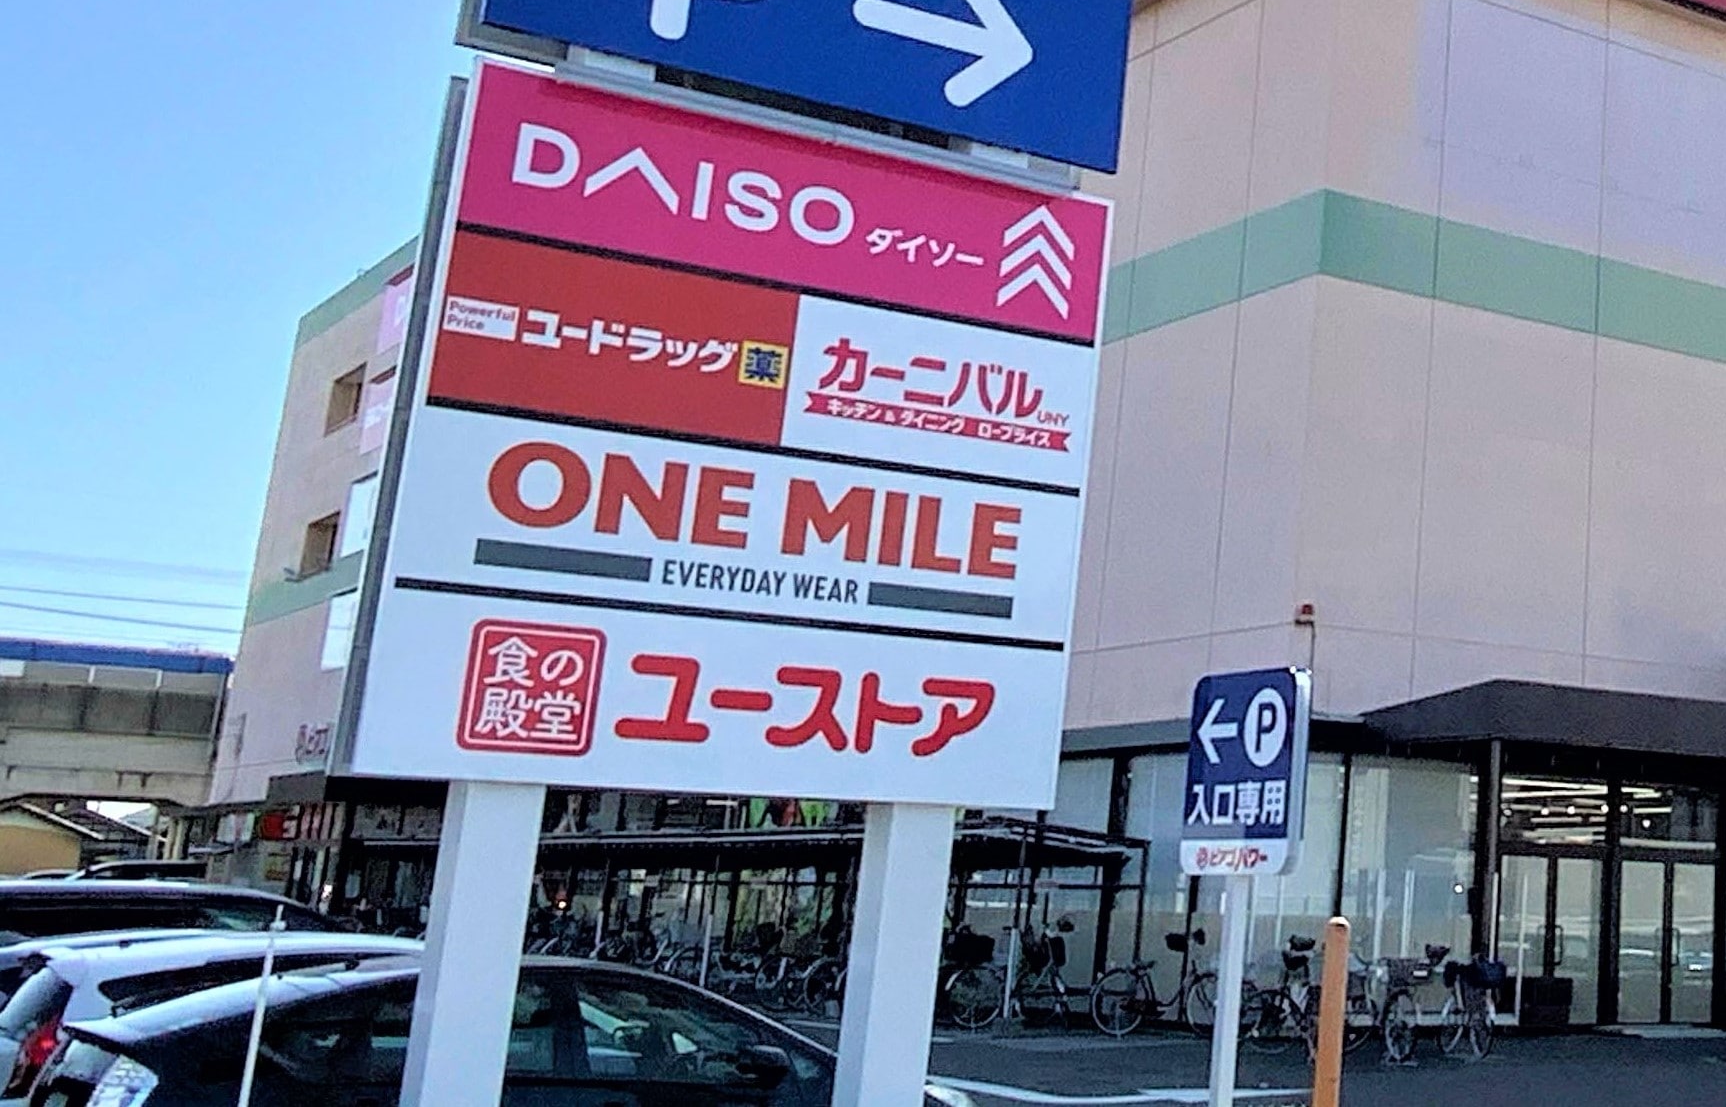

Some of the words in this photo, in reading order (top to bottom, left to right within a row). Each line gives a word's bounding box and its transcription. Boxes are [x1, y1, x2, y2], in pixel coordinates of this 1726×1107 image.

[512, 123, 854, 245] DAISO
[864, 226, 985, 268] ダイソー
[446, 313, 485, 331] Price
[449, 300, 517, 323] Powerful
[520, 308, 739, 374] ユードラッグ
[743, 346, 784, 383] 薬
[818, 337, 1044, 419] カーニバル
[977, 425, 1052, 448] ロープライス
[1036, 410, 1071, 427] UNY
[487, 441, 756, 550] ONE
[781, 477, 1023, 580] MILE
[661, 560, 787, 596] EVERYDAY
[793, 571, 859, 605] WEAR
[482, 635, 585, 689] 食の
[474, 687, 582, 740] 殿堂
[613, 653, 996, 757] ユーストア
[1187, 779, 1287, 826] 入口専用
